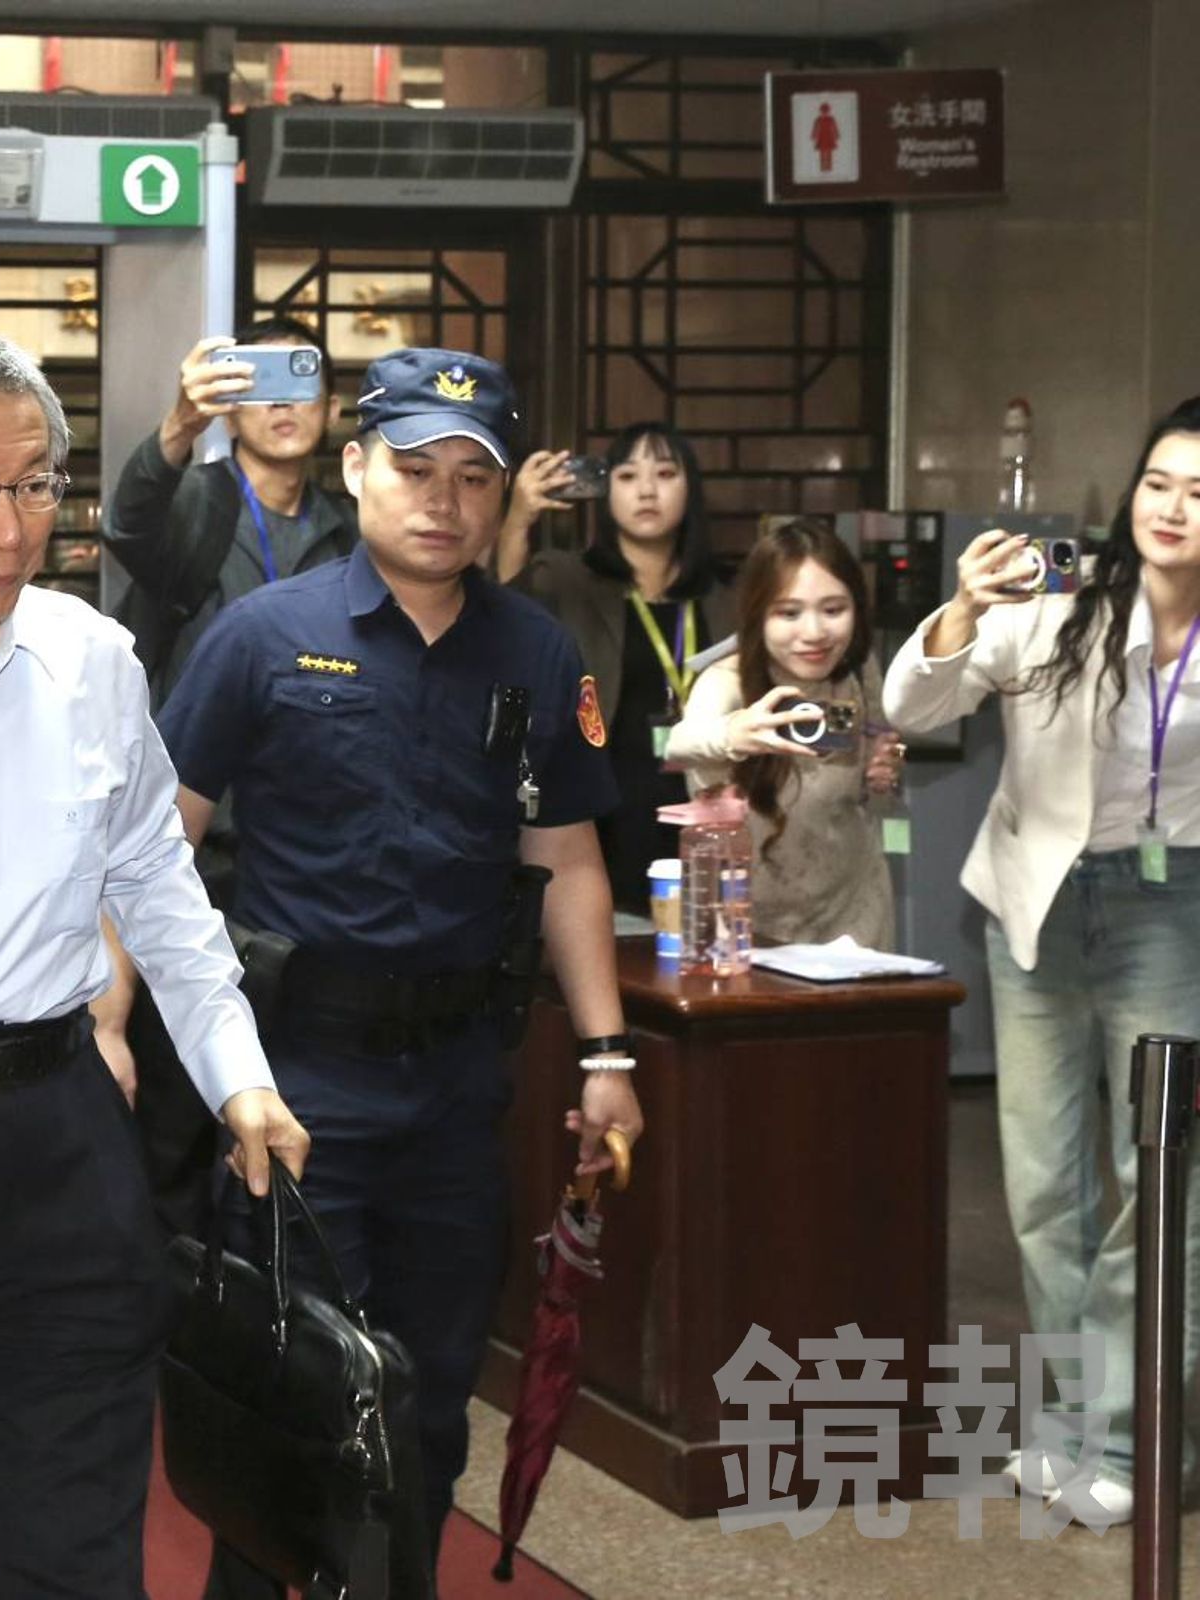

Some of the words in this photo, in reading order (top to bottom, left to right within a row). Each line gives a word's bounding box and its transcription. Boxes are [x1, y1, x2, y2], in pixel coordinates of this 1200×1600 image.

[889, 98, 987, 128] 女洗手間
[898, 138, 976, 154] Women's
[897, 154, 979, 169] Restroom
